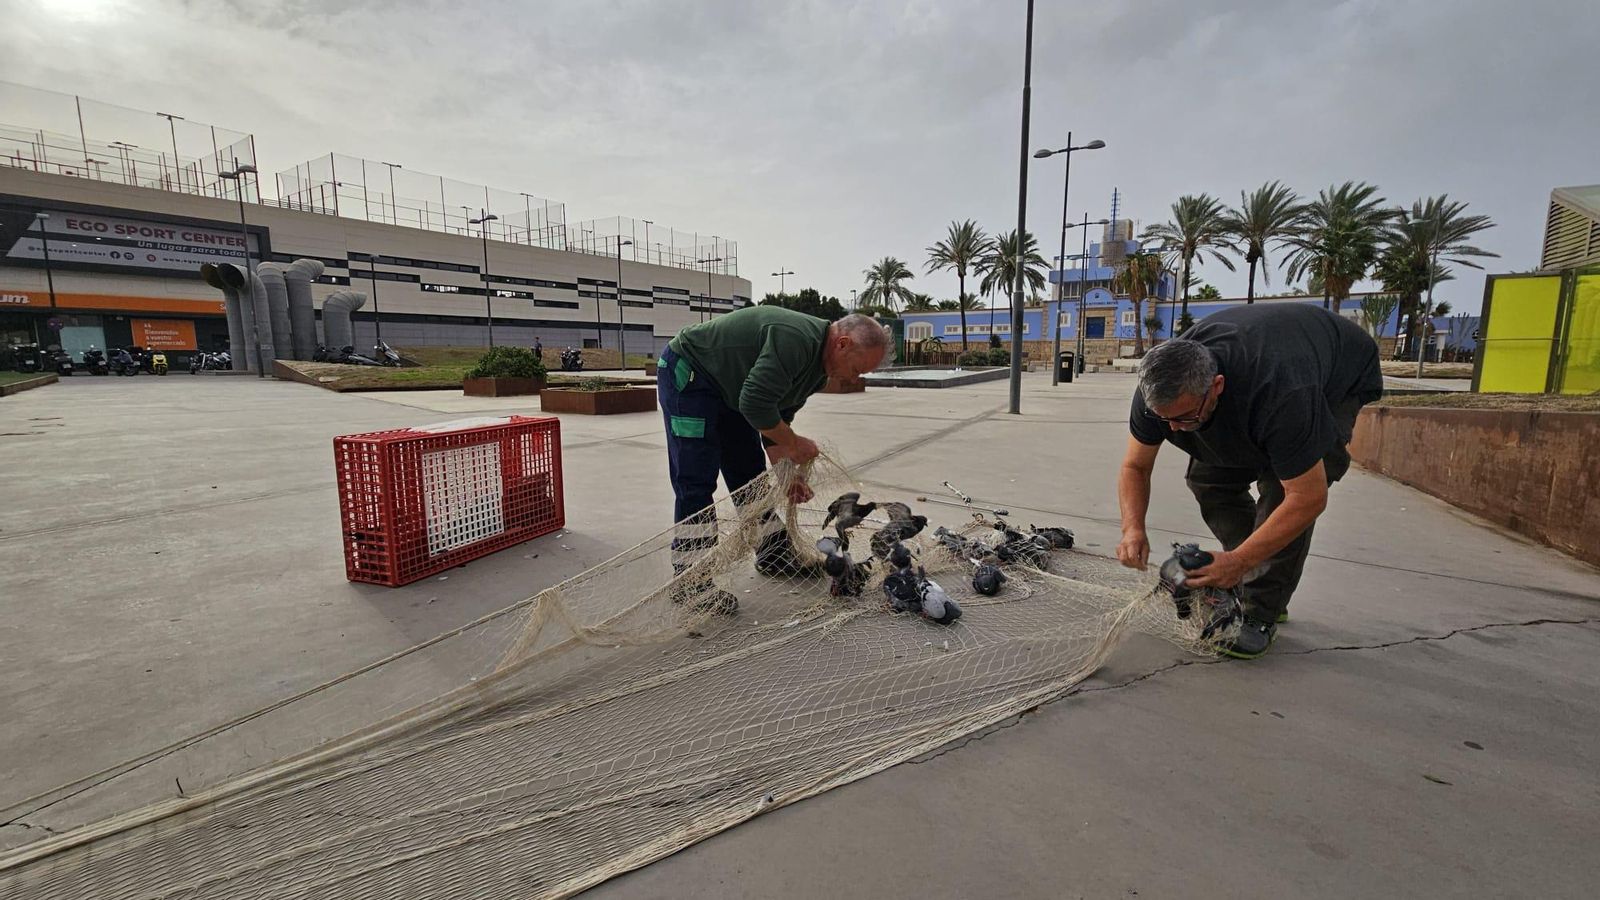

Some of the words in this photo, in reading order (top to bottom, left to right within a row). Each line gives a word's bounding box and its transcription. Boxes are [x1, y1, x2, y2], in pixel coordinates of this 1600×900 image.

[66, 218, 108, 232] EGO
[115, 224, 176, 240] SPORT
[181, 231, 247, 248] CENTER
[137, 240, 153, 248] Un
[157, 242, 187, 252] lugar
[190, 246, 216, 255] para
[219, 249, 247, 257] todos
